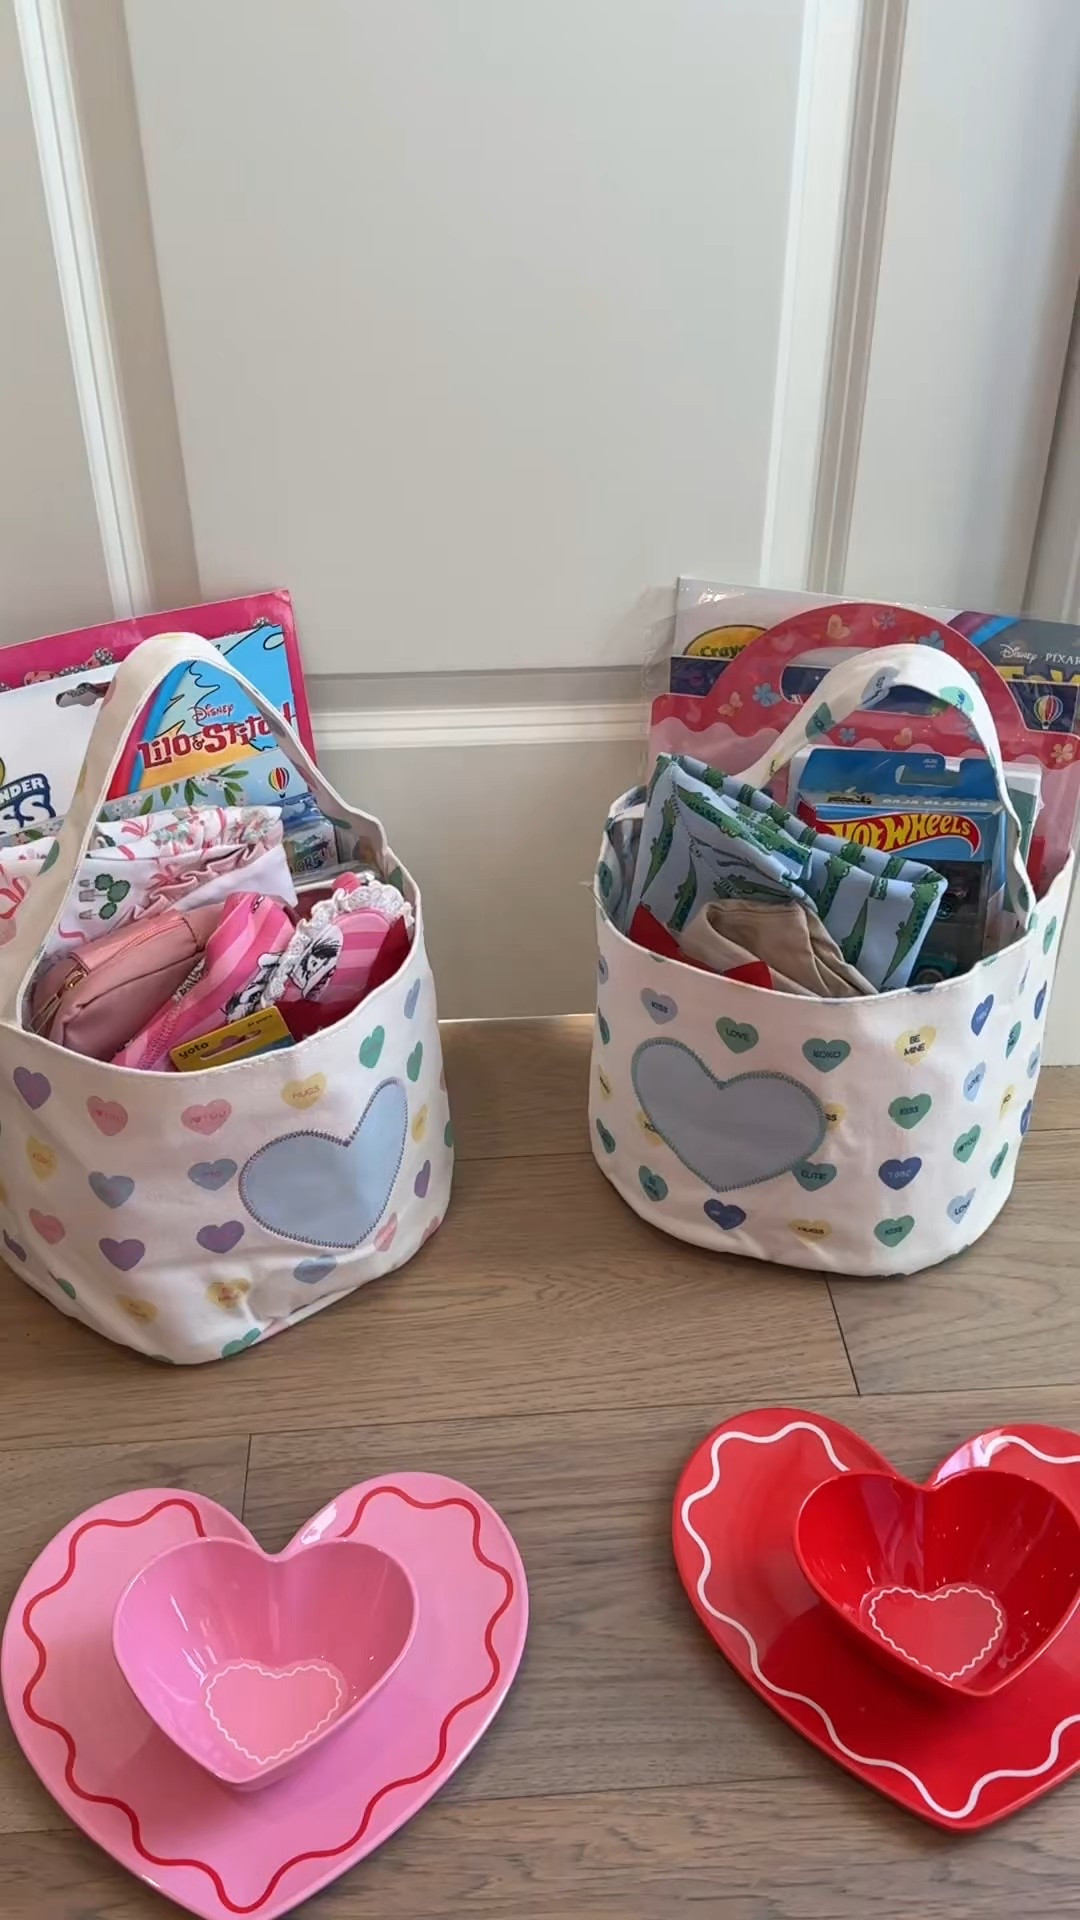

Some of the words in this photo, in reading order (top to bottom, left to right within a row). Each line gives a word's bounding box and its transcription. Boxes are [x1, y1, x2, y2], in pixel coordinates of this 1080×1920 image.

[1000, 643, 1038, 664] Disney
[1045, 652, 1080, 665] PIXAR
[178, 1041, 210, 1060] yoto
[903, 1042, 926, 1057] MINE
